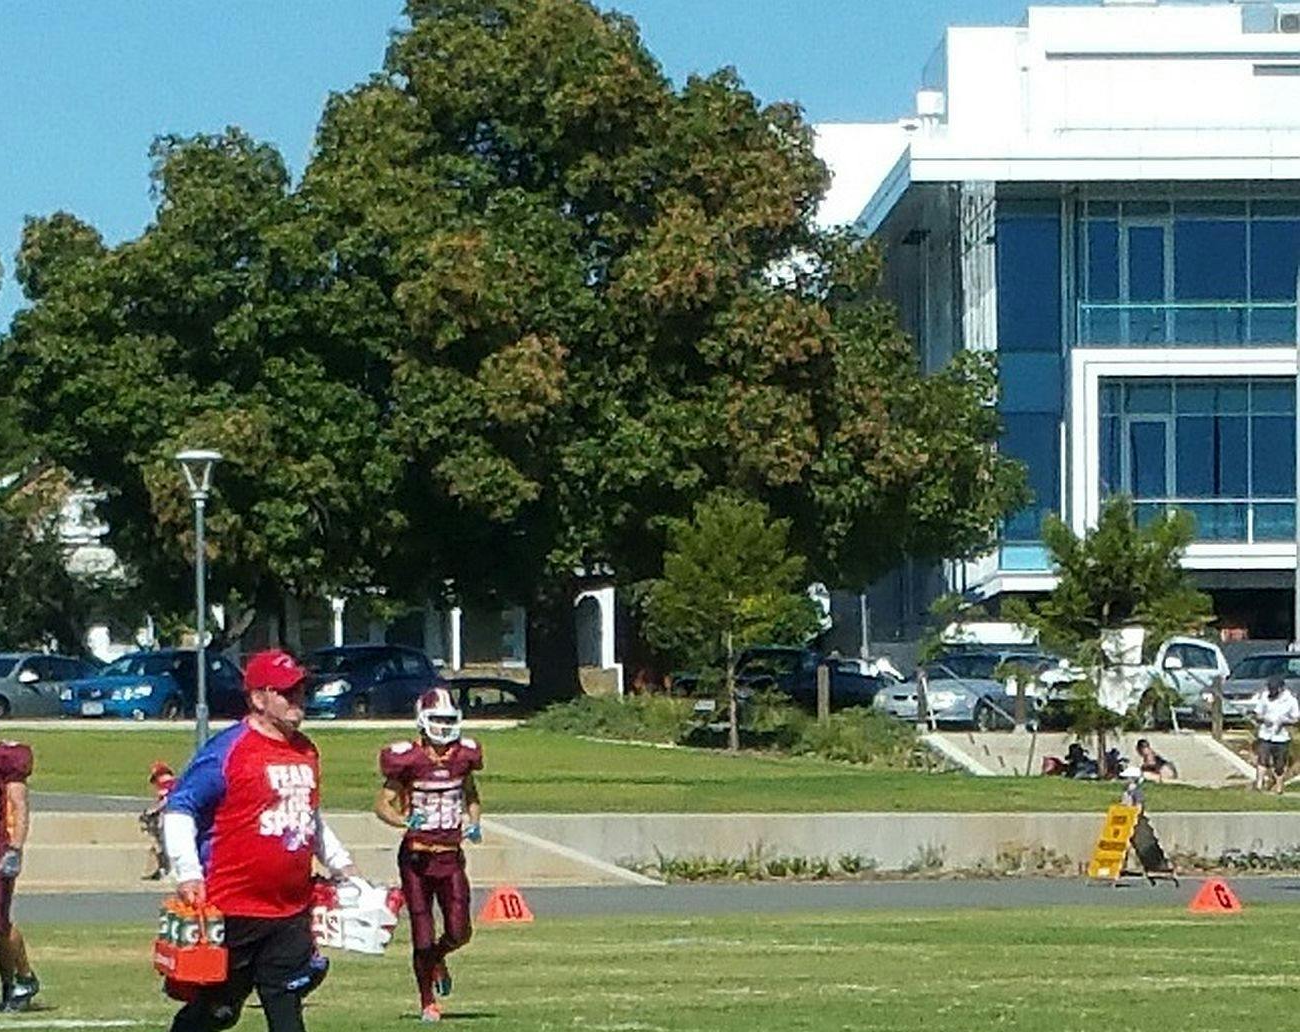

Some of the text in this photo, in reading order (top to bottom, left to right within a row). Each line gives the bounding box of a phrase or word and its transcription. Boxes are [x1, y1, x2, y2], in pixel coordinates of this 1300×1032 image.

[264, 763, 316, 789] FEAR
[499, 894, 523, 919] 10
[1213, 883, 1233, 909] G
